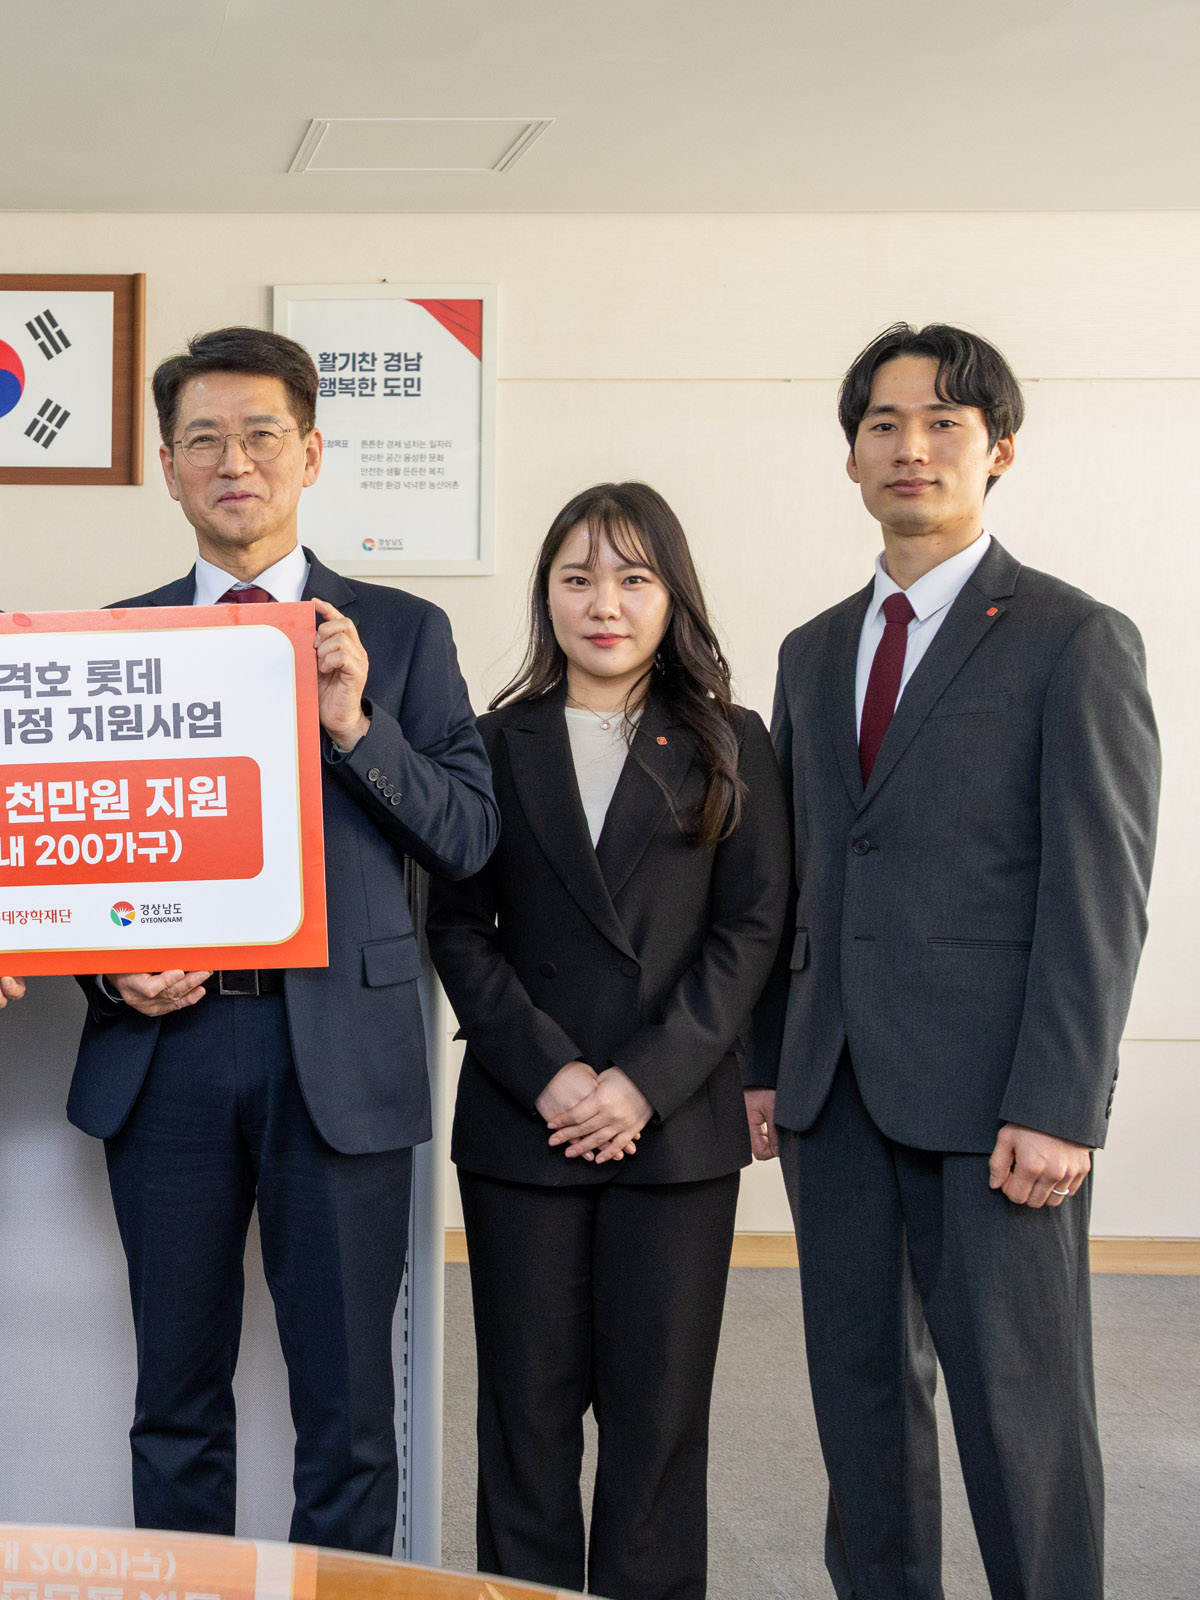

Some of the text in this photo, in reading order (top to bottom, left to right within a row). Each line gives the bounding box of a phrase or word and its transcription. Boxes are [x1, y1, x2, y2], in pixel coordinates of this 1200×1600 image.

[318, 352, 422, 372] 활기찬 경남
[318, 377, 422, 398] 행복한 도민
[361, 440, 452, 449] 튼튼한 경제 넘치는 일자리
[361, 454, 383, 462] 편리한
[386, 454, 401, 462] 공간
[429, 454, 444, 462] 문화
[360, 467, 444, 476] 안전한 생활 든든한 복지
[360, 481, 459, 489] 쾌적한 환경 넉넉한 농산어촌
[87, 658, 162, 697] 롯데
[68, 701, 222, 742] 지원사업
[146, 776, 228, 818] 지원
[35, 830, 182, 866] 200가구)
[140, 903, 182, 916] 경상남도
[140, 916, 182, 924] GYEONGNAM
